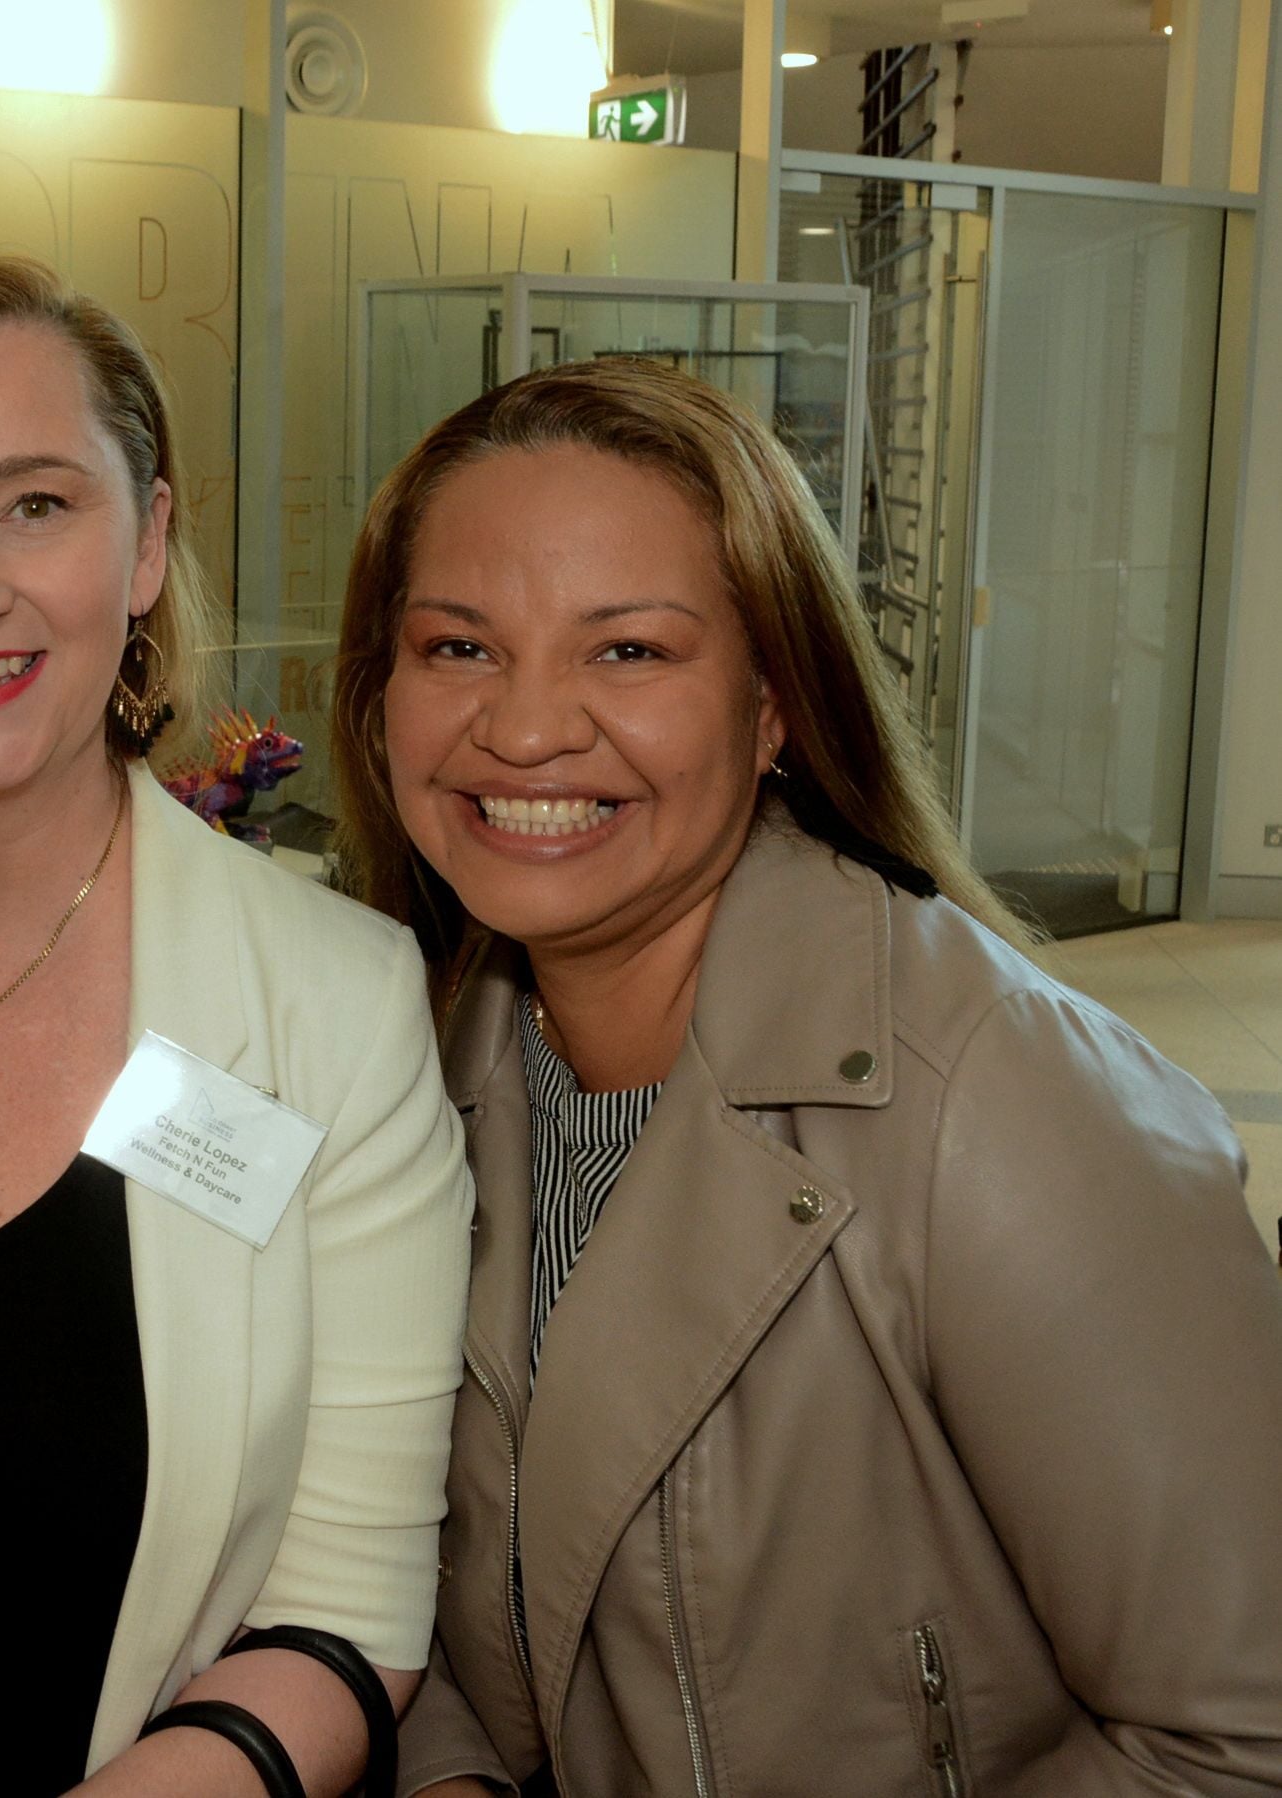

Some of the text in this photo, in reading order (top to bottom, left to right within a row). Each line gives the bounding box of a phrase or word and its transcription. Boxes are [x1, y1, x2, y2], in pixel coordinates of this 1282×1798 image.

[131, 1137, 242, 1205] Wellness & Daycare
[155, 1115, 200, 1148] Cherie
[203, 1140, 248, 1172] Lopez
[158, 1136, 227, 1180] Fetch N Fun
